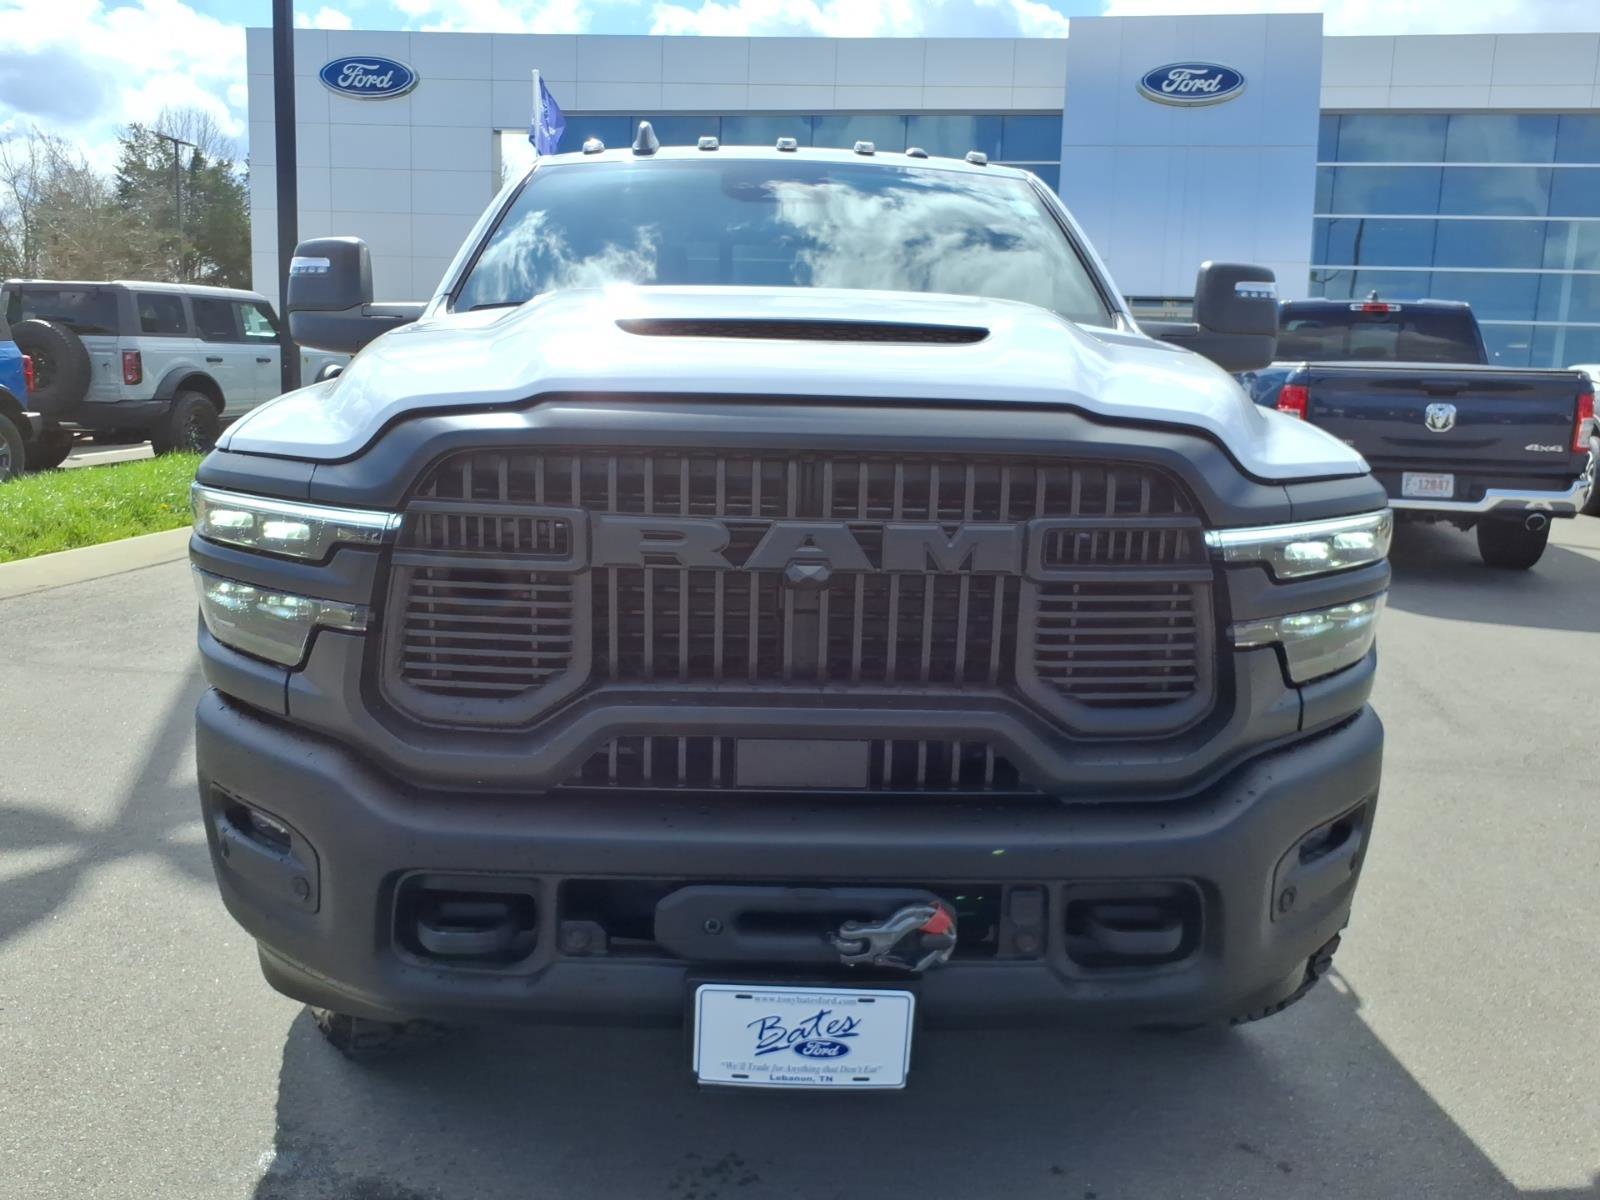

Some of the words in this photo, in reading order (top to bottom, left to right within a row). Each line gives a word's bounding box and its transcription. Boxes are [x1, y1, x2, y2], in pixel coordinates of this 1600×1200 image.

[338, 63, 394, 88] Ford
[1161, 68, 1223, 92] Ford
[592, 515, 1024, 573] RAM
[747, 1009, 862, 1053] Bates
[803, 1040, 841, 1057] Ford
[769, 1074, 815, 1083] Lebanon,
[819, 1075, 833, 1083] TN
[786, 1064, 823, 1074] Anything
[824, 1065, 840, 1074] that
